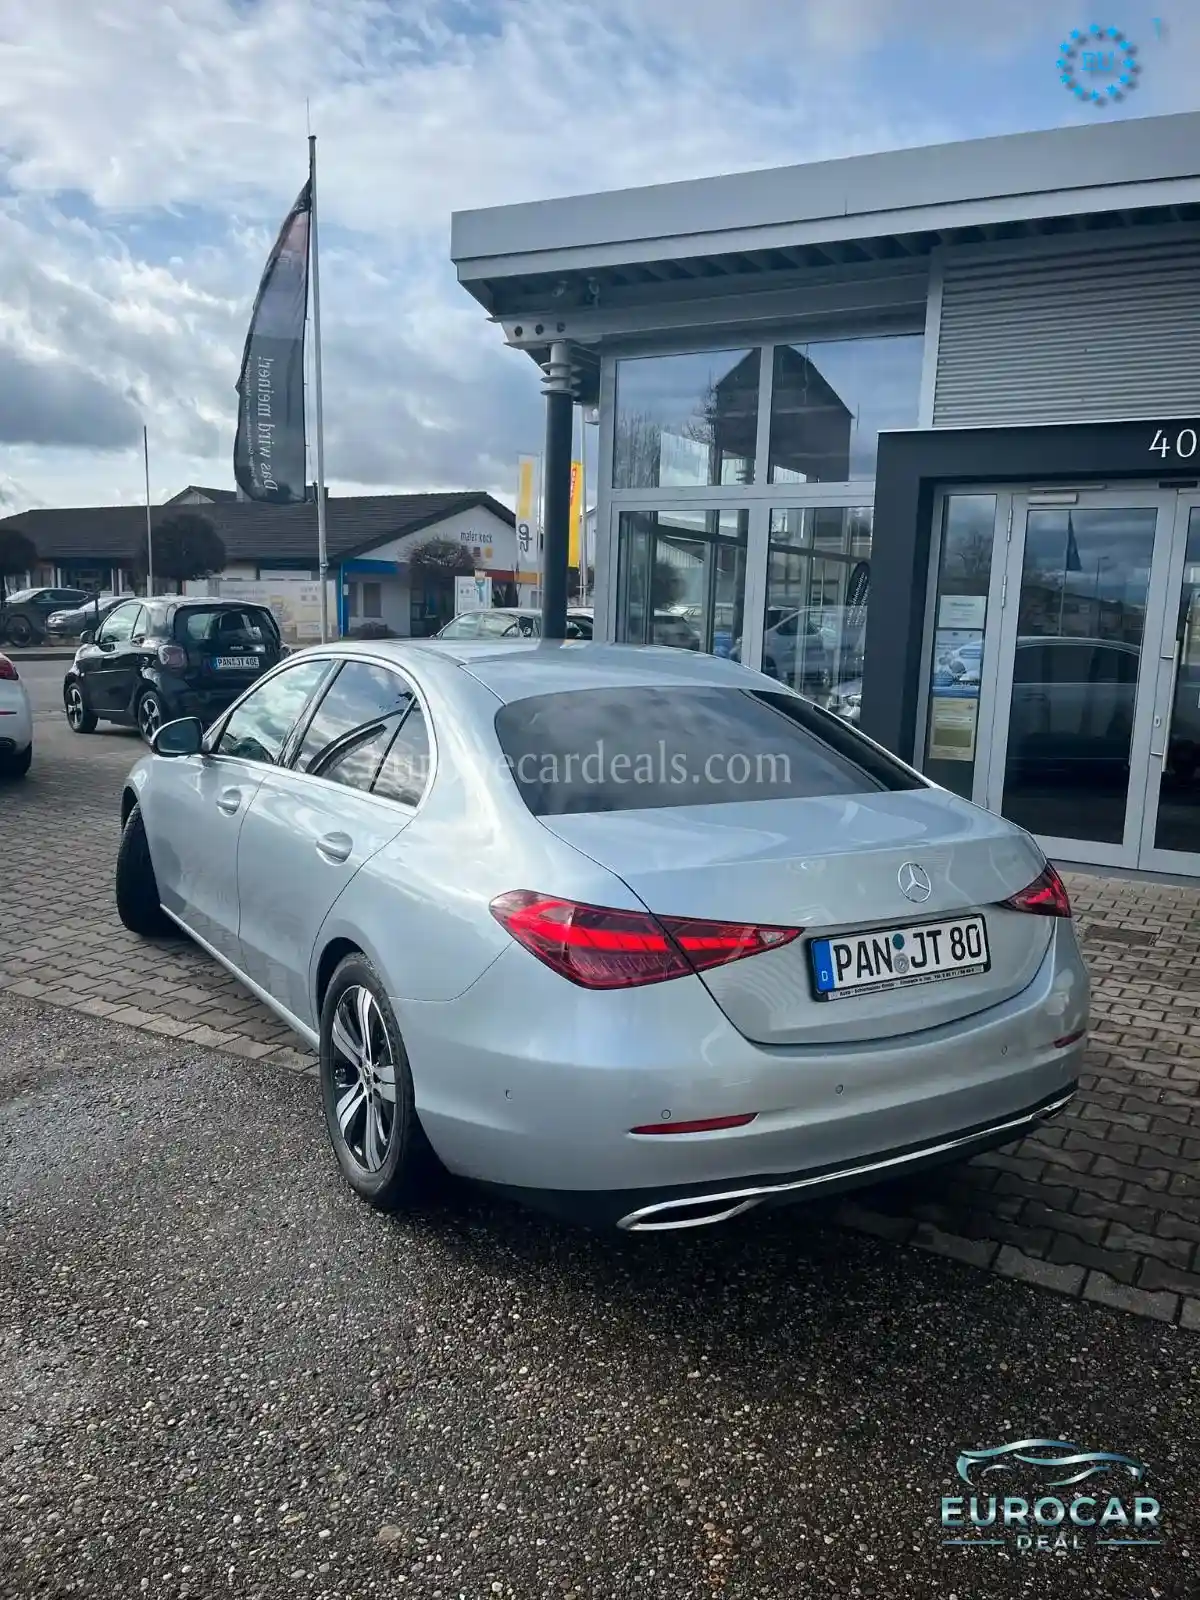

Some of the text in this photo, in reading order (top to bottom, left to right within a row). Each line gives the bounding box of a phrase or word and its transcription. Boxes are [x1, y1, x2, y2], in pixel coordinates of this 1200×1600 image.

[1149, 428, 1197, 458] 40
[833, 937, 893, 982] PAN
[911, 930, 942, 968] JT
[950, 924, 982, 961] 80
